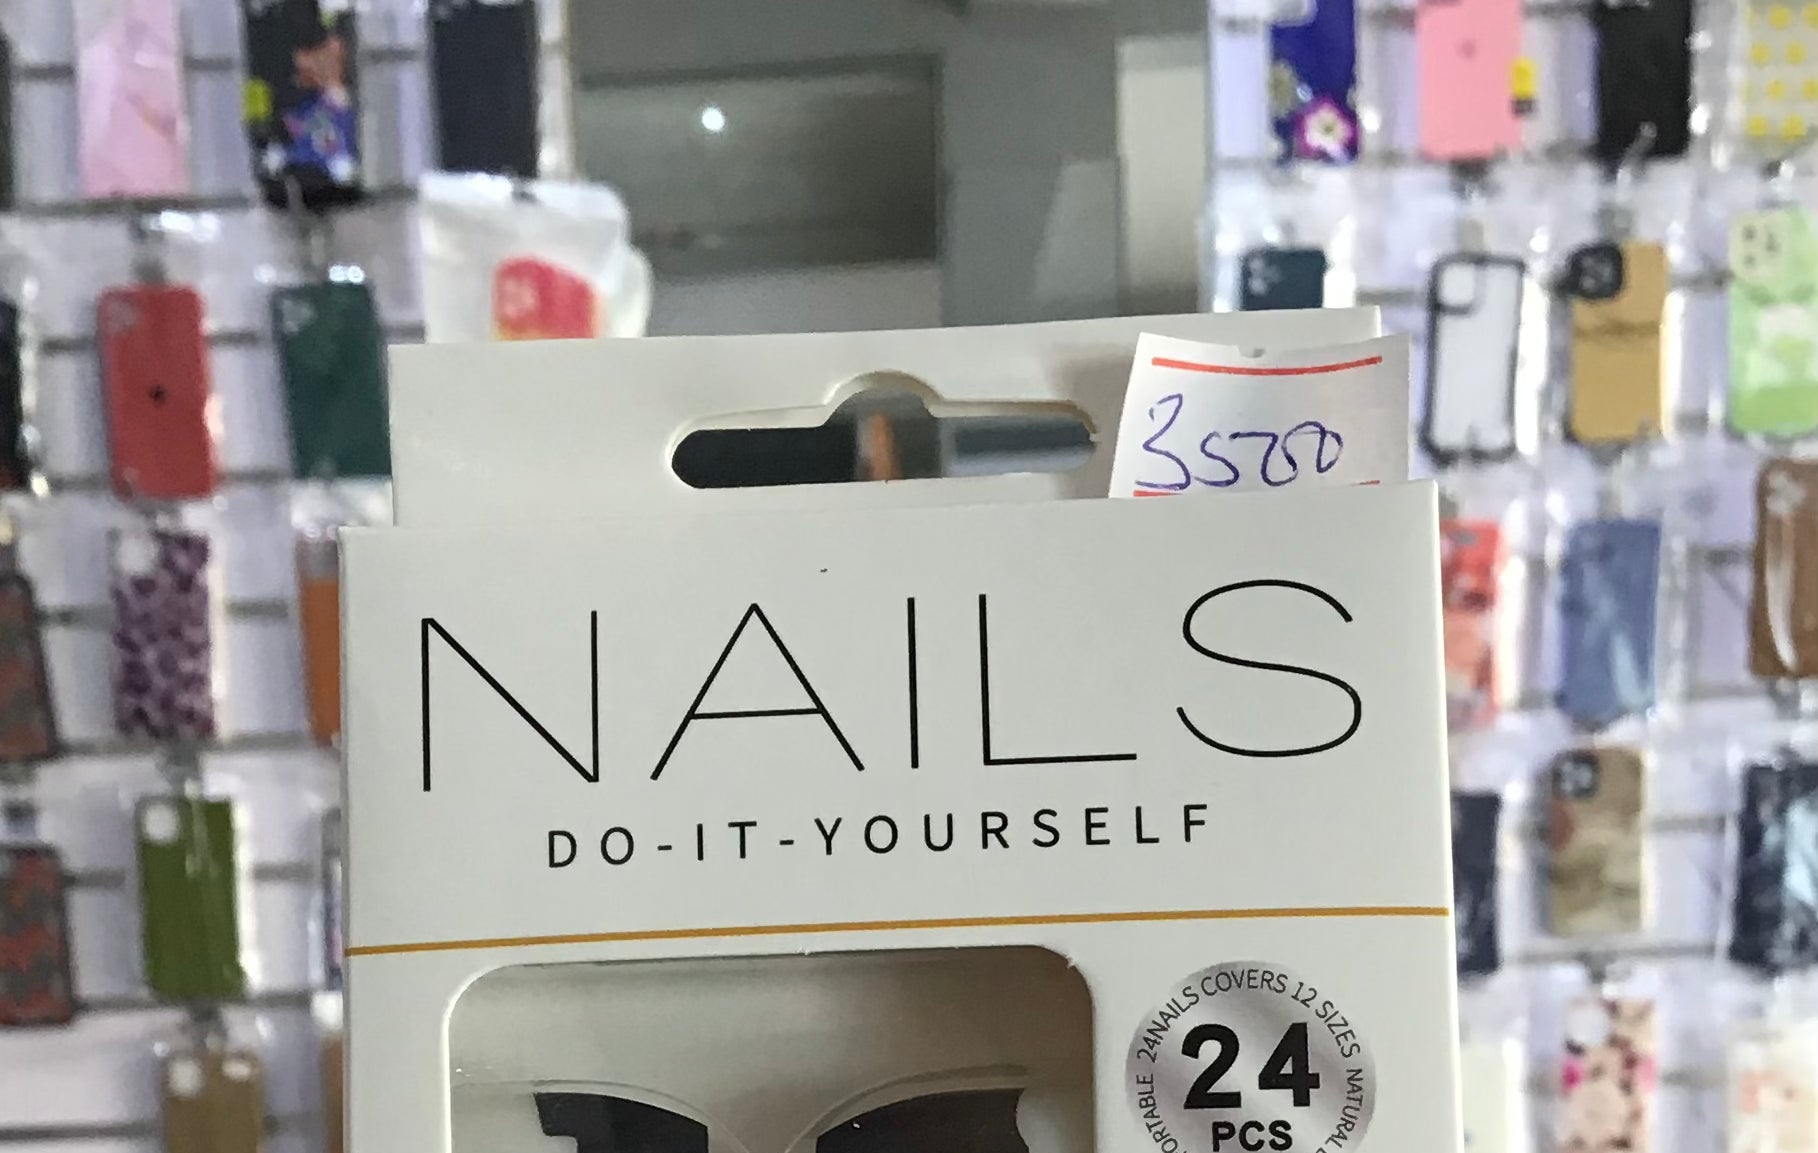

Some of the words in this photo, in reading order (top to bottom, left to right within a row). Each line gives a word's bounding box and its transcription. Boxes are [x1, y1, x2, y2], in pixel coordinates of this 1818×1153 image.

[421, 579, 1363, 793] NAILS
[547, 803, 1210, 869] DO-IT-YOURSELF
[1200, 968, 1289, 997] COVERS
[1290, 981, 1318, 1009] 12
[1314, 1000, 1361, 1059] SIZES
[1180, 1021, 1321, 1109] 24
[1211, 1119, 1294, 1153] PCS
[1324, 1067, 1364, 1149] NATURAL
